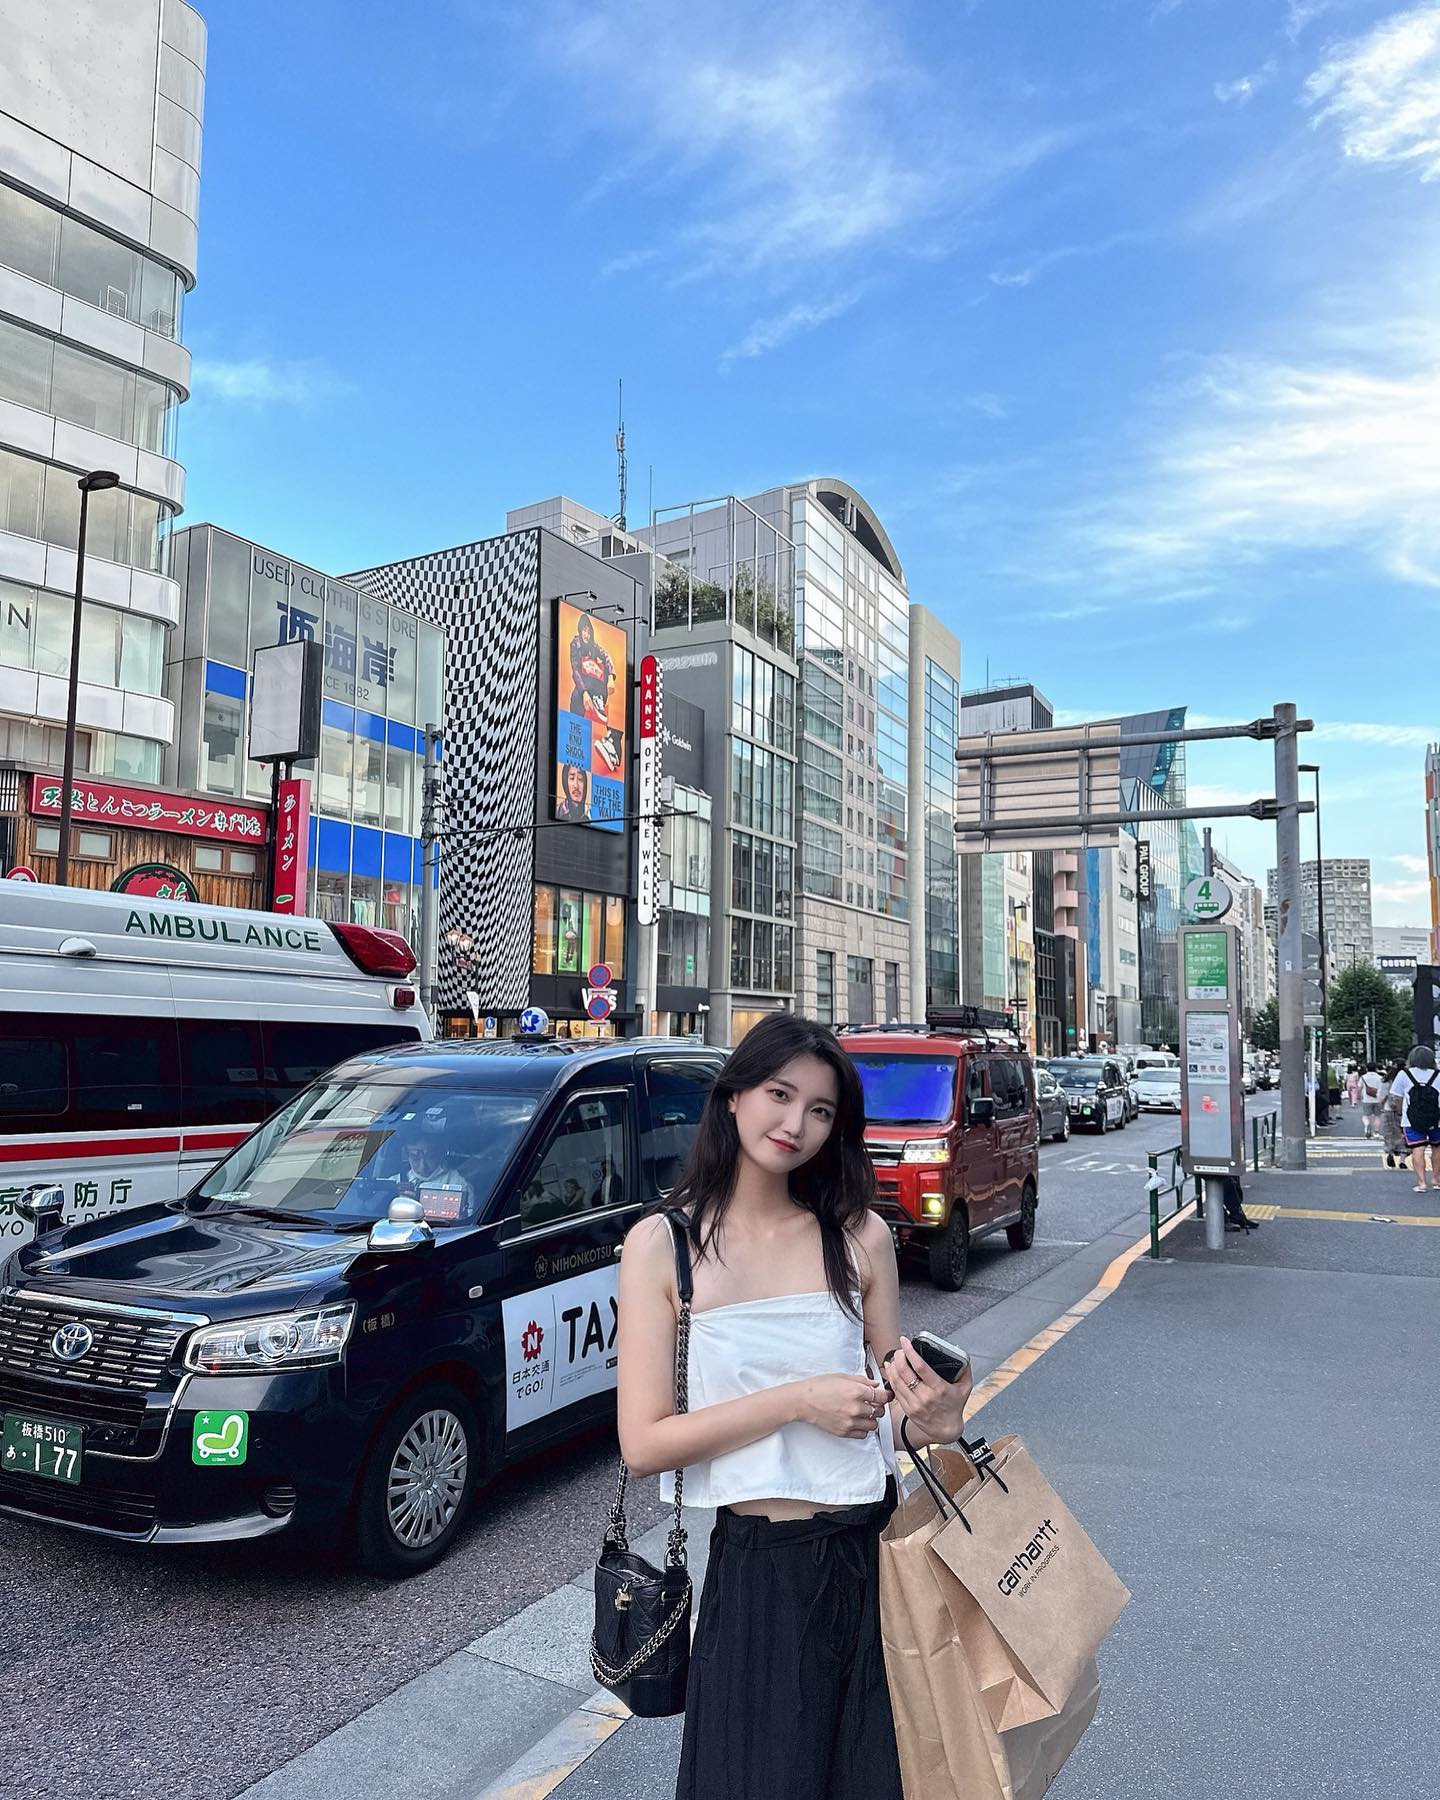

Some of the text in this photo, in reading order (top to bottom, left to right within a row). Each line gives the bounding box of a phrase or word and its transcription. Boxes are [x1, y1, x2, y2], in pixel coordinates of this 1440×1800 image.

[254, 555, 295, 586] USED
[375, 608, 416, 640] SORE
[343, 682, 369, 700] 1982
[569, 721, 582, 733] THE
[671, 734, 692, 752] Goldwin
[594, 796, 622, 812] OFF THE
[596, 784, 620, 799] THIS IS
[281, 793, 296, 871] ラーメン
[643, 798, 651, 839] THE
[642, 850, 651, 906] WALL
[1140, 845, 1150, 897] PAL GROUP
[1198, 880, 1212, 900] 4
[125, 910, 322, 952] AMBULANCE
[551, 1244, 612, 1274] NIHONKOTSU
[512, 1359, 550, 1384] 日本交通
[516, 1378, 544, 1399] でGO!
[997, 1518, 1057, 1596] carhartt
[1018, 1544, 1060, 1598] WORK IN PROGRESS
